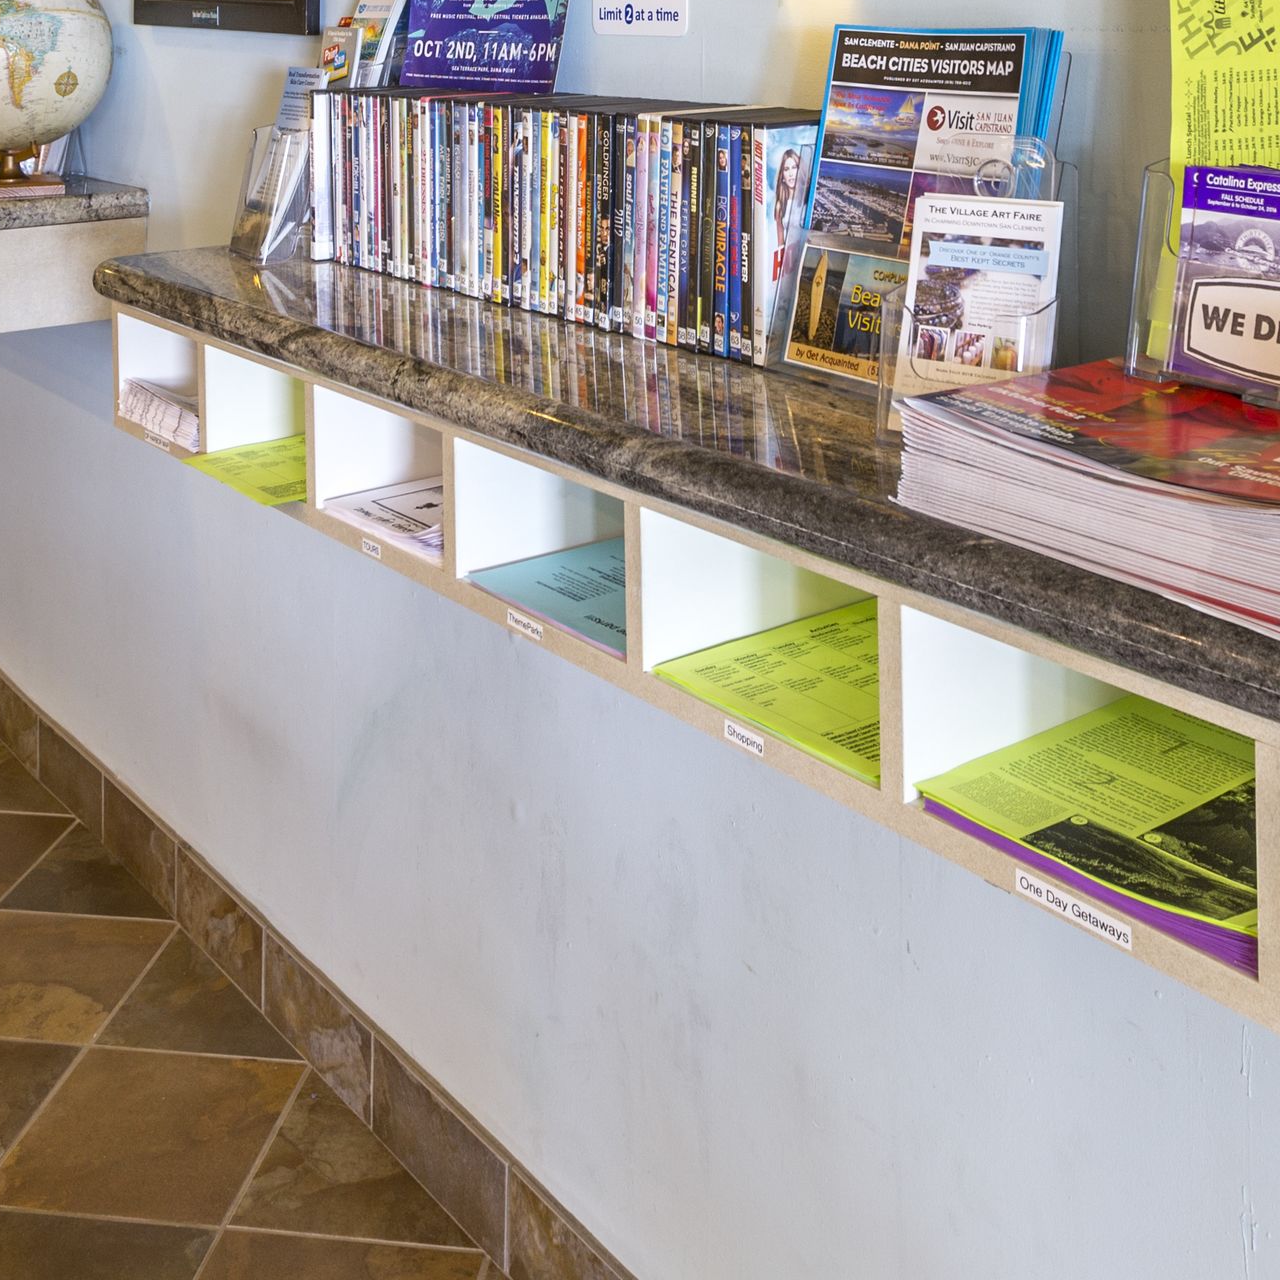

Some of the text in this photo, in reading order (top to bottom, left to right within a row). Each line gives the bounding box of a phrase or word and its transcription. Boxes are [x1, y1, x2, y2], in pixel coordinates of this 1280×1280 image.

[599, 8, 622, 20] Limit
[635, 9, 644, 20] at
[648, 11, 653, 20] a
[656, 8, 678, 21] time
[413, 40, 557, 62] OCT 2ND, 11AM-6PM
[844, 37, 1016, 51] SAN CLEMENTE DANA POINT SAN JUAN CAPISTRANO
[842, 54, 1014, 75] BEACH CITIES VISITORS MAP
[948, 110, 975, 131] Visit
[977, 112, 1013, 122] SAN JUAN
[975, 124, 1013, 133] CAPISTRANO
[422, 150, 426, 164] 27
[660, 158, 669, 205] FAITH
[754, 140, 763, 206] HOT PURSUIT
[1206, 174, 1244, 187] Catalina
[1208, 199, 1230, 207] September
[1235, 196, 1264, 205] SCHEDULE
[614, 208, 623, 237] 2012
[625, 204, 633, 244] surfer
[991, 210, 1011, 219] ART
[1014, 212, 1041, 221] FAIRE
[668, 190, 678, 302] THE IDENTICAL
[680, 200, 689, 273] EFFIE GRAY
[715, 196, 727, 293] BIG MIRACLE
[658, 233, 667, 293] FAMILY
[741, 233, 749, 283] FIGHTER
[635, 315, 642, 326] 50
[647, 314, 654, 323] 51
[1202, 304, 1246, 336] WE
[731, 336, 739, 345] 63
[742, 340, 751, 352] 66
[796, 348, 804, 357] by
[806, 351, 818, 360] Get
[821, 354, 859, 371] Acquainted
[1197, 456, 1229, 468] Our
[362, 540, 380, 556] TOURS
[727, 724, 762, 753] Shopping
[1019, 876, 1130, 945] One Day Getaways
